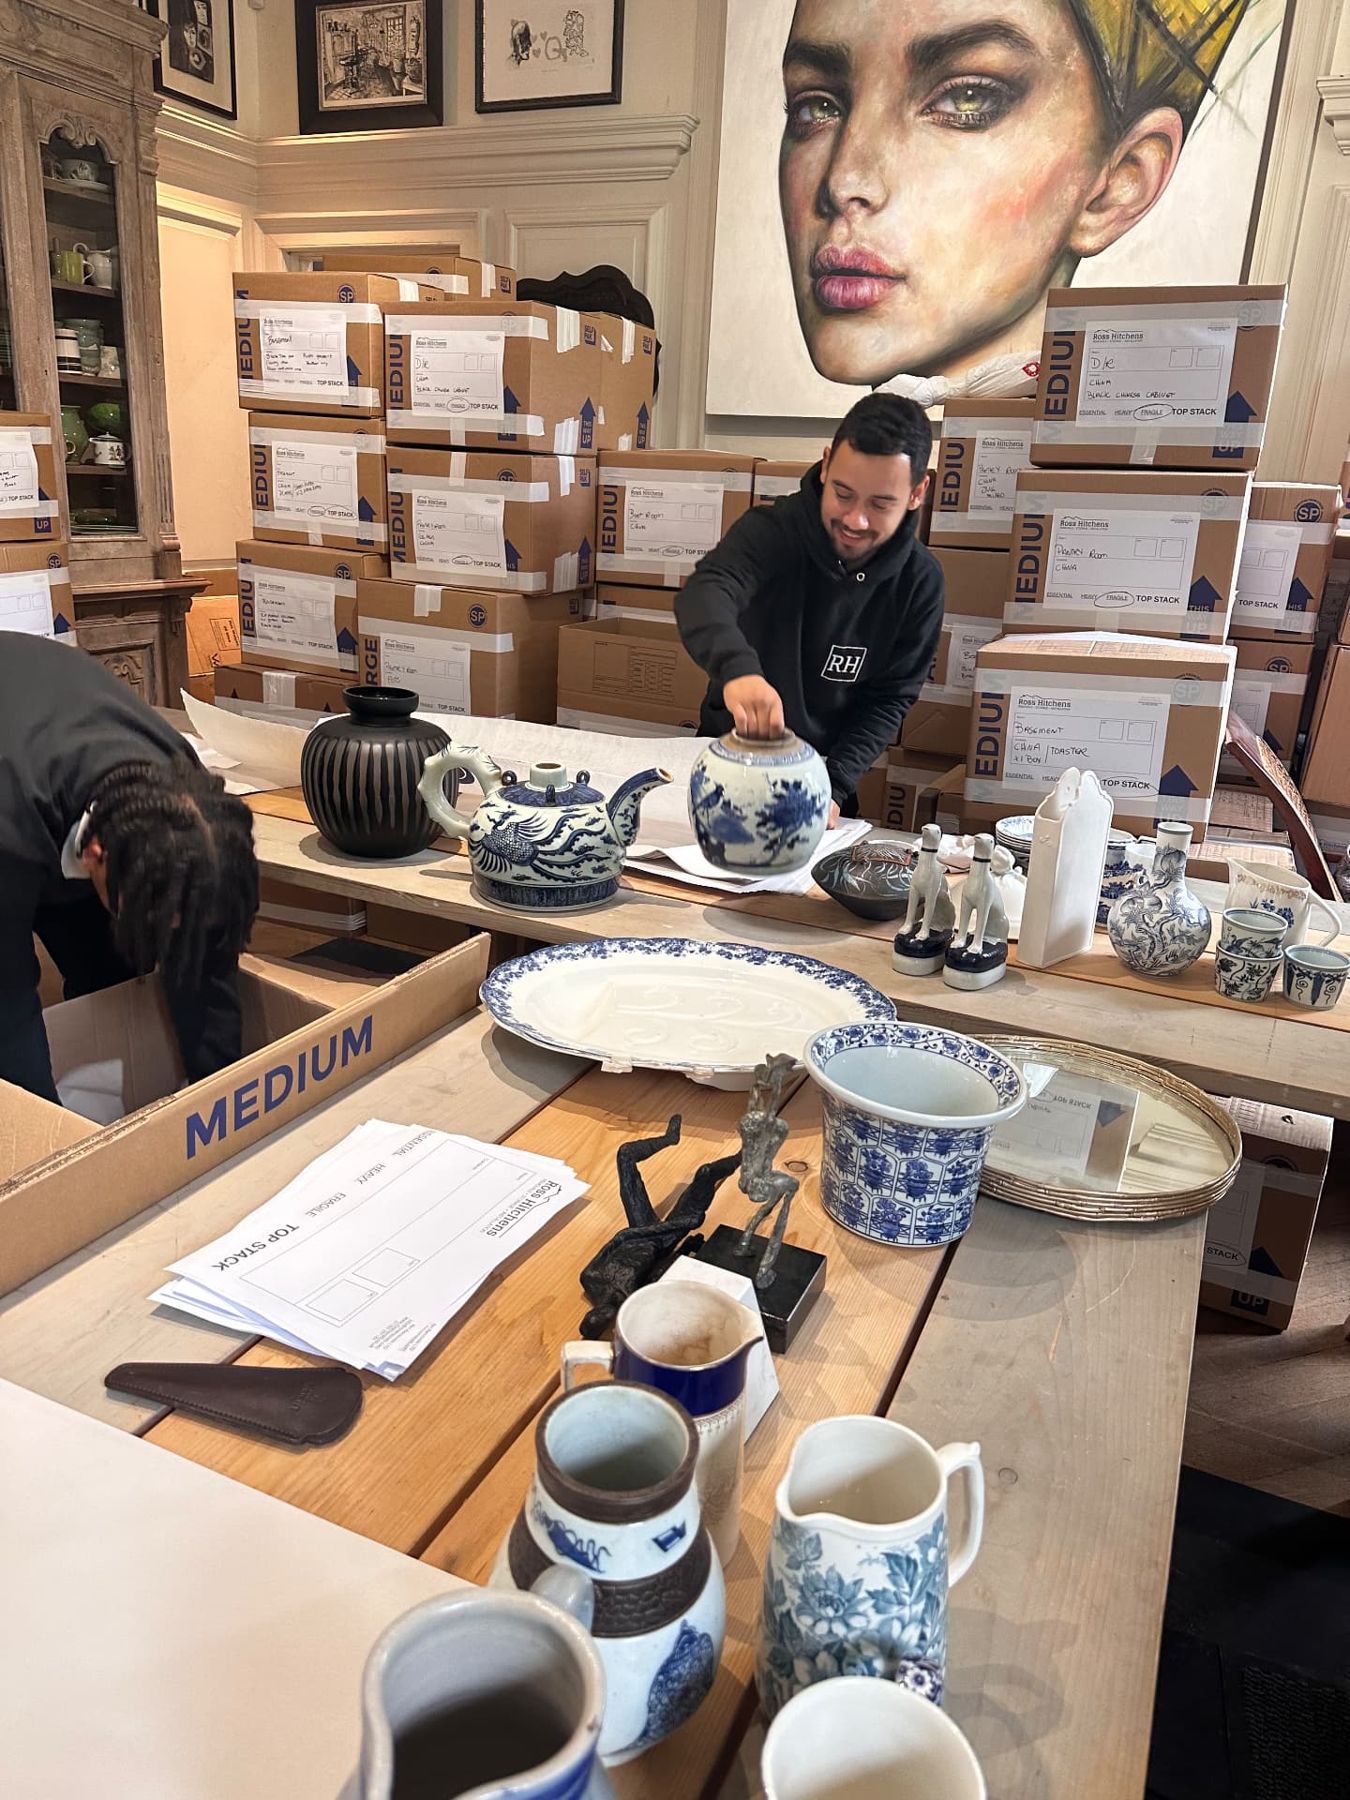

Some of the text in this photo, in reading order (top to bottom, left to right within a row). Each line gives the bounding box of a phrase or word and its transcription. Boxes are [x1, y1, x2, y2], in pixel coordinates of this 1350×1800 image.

[1111, 332, 1143, 340] Hitchens
[1171, 408, 1189, 416] TOP
[1190, 407, 1216, 416] STACK
[582, 435, 592, 444] UP
[1297, 508, 1320, 521] SP
[36, 521, 49, 529] UP
[1078, 520, 1109, 528] Hitchens
[1154, 596, 1179, 604] STACK
[1238, 599, 1279, 609] TOP STACK
[470, 610, 486, 623] SP
[365, 638, 379, 686] RGE
[827, 654, 861, 673] RH
[448, 705, 465, 713] STACK
[1018, 698, 1071, 708] Ross Hitchens
[1103, 779, 1120, 787] TOP
[1122, 782, 1150, 790] STACK
[186, 1014, 374, 1161] MEDIUM
[305, 1192, 347, 1218] FRAGILE
[486, 1180, 560, 1237] Ross Hitchens
[268, 1224, 300, 1243] TOP
[211, 1241, 267, 1272] STACK
[1206, 1246, 1240, 1261] STACK
